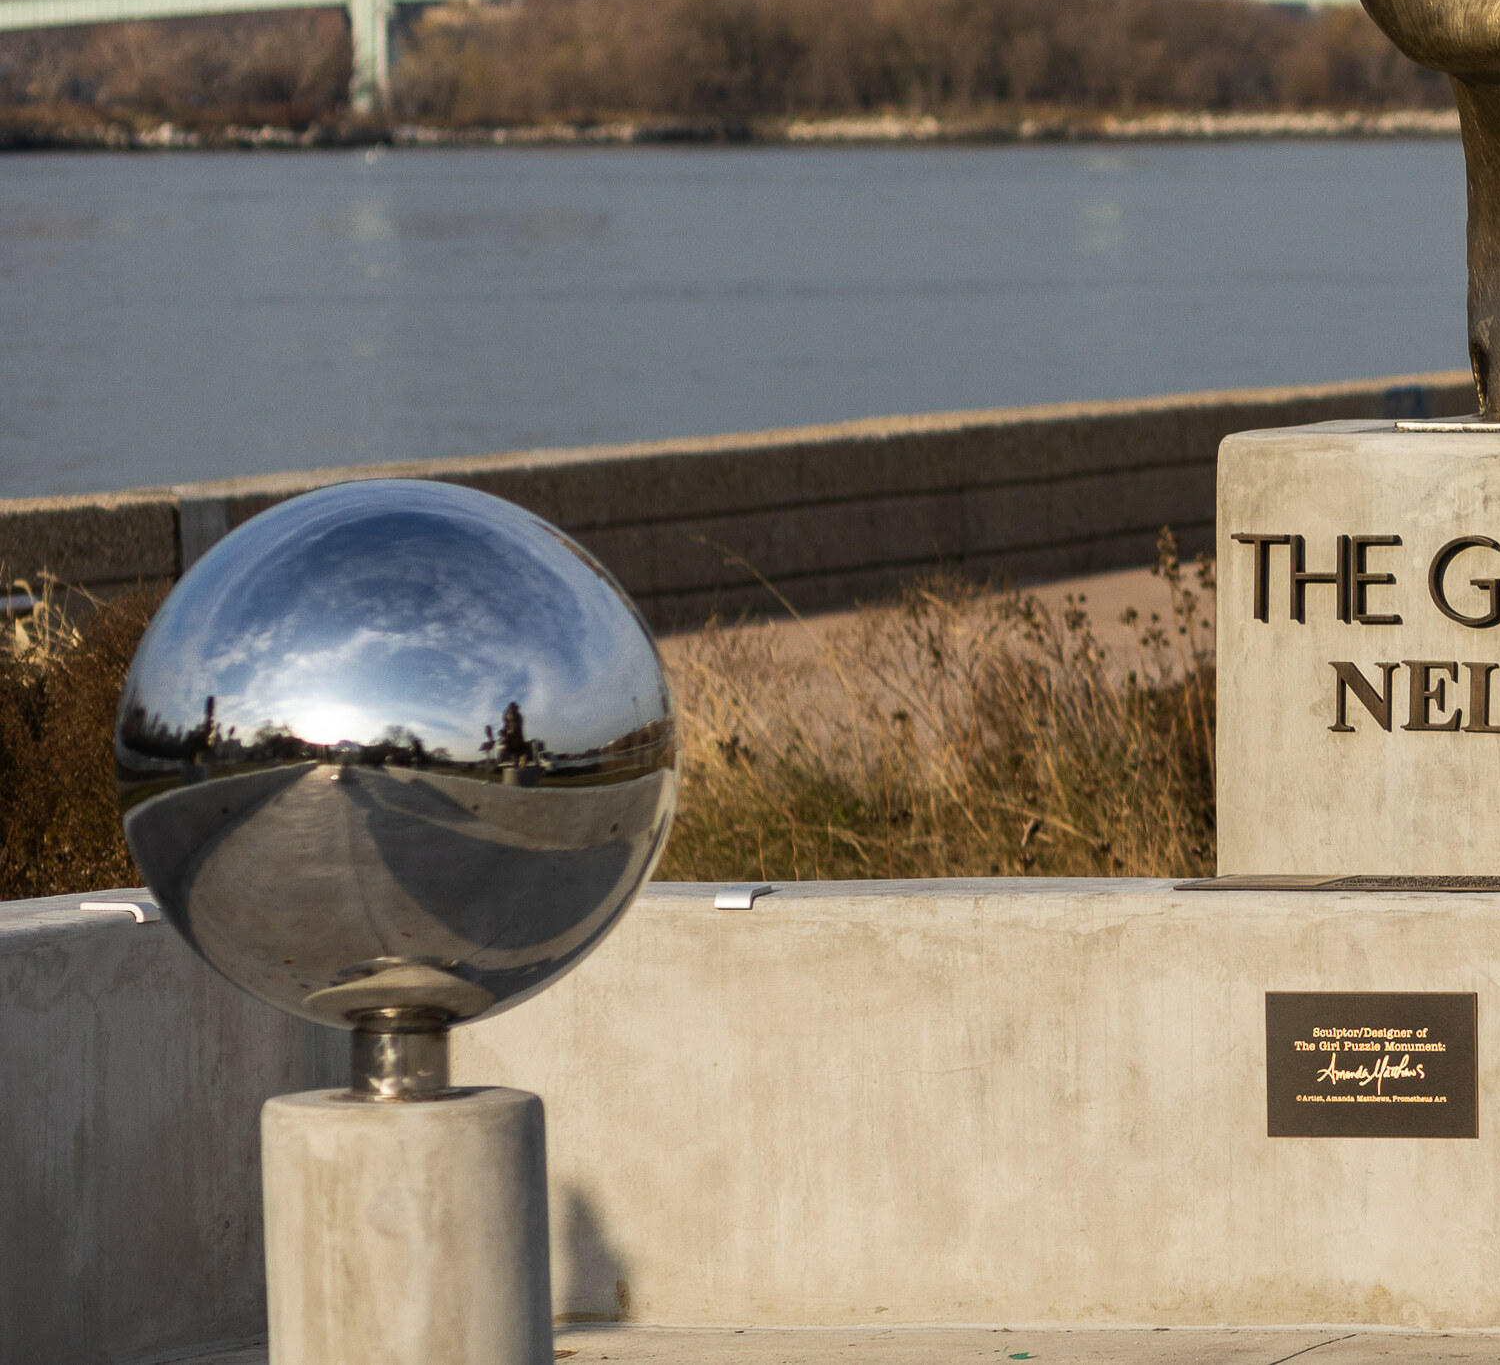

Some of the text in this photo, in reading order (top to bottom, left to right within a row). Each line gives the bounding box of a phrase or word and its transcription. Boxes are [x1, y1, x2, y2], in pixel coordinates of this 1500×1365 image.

[1231, 533, 1403, 625] THE
[1313, 1027, 1429, 1039] Sculptor/Designer of
[1294, 1041, 1446, 1051] The Girl Puzzle Monument:
[1326, 1095, 1355, 1103] Amanda
[1392, 1095, 1433, 1103] Prometheus
